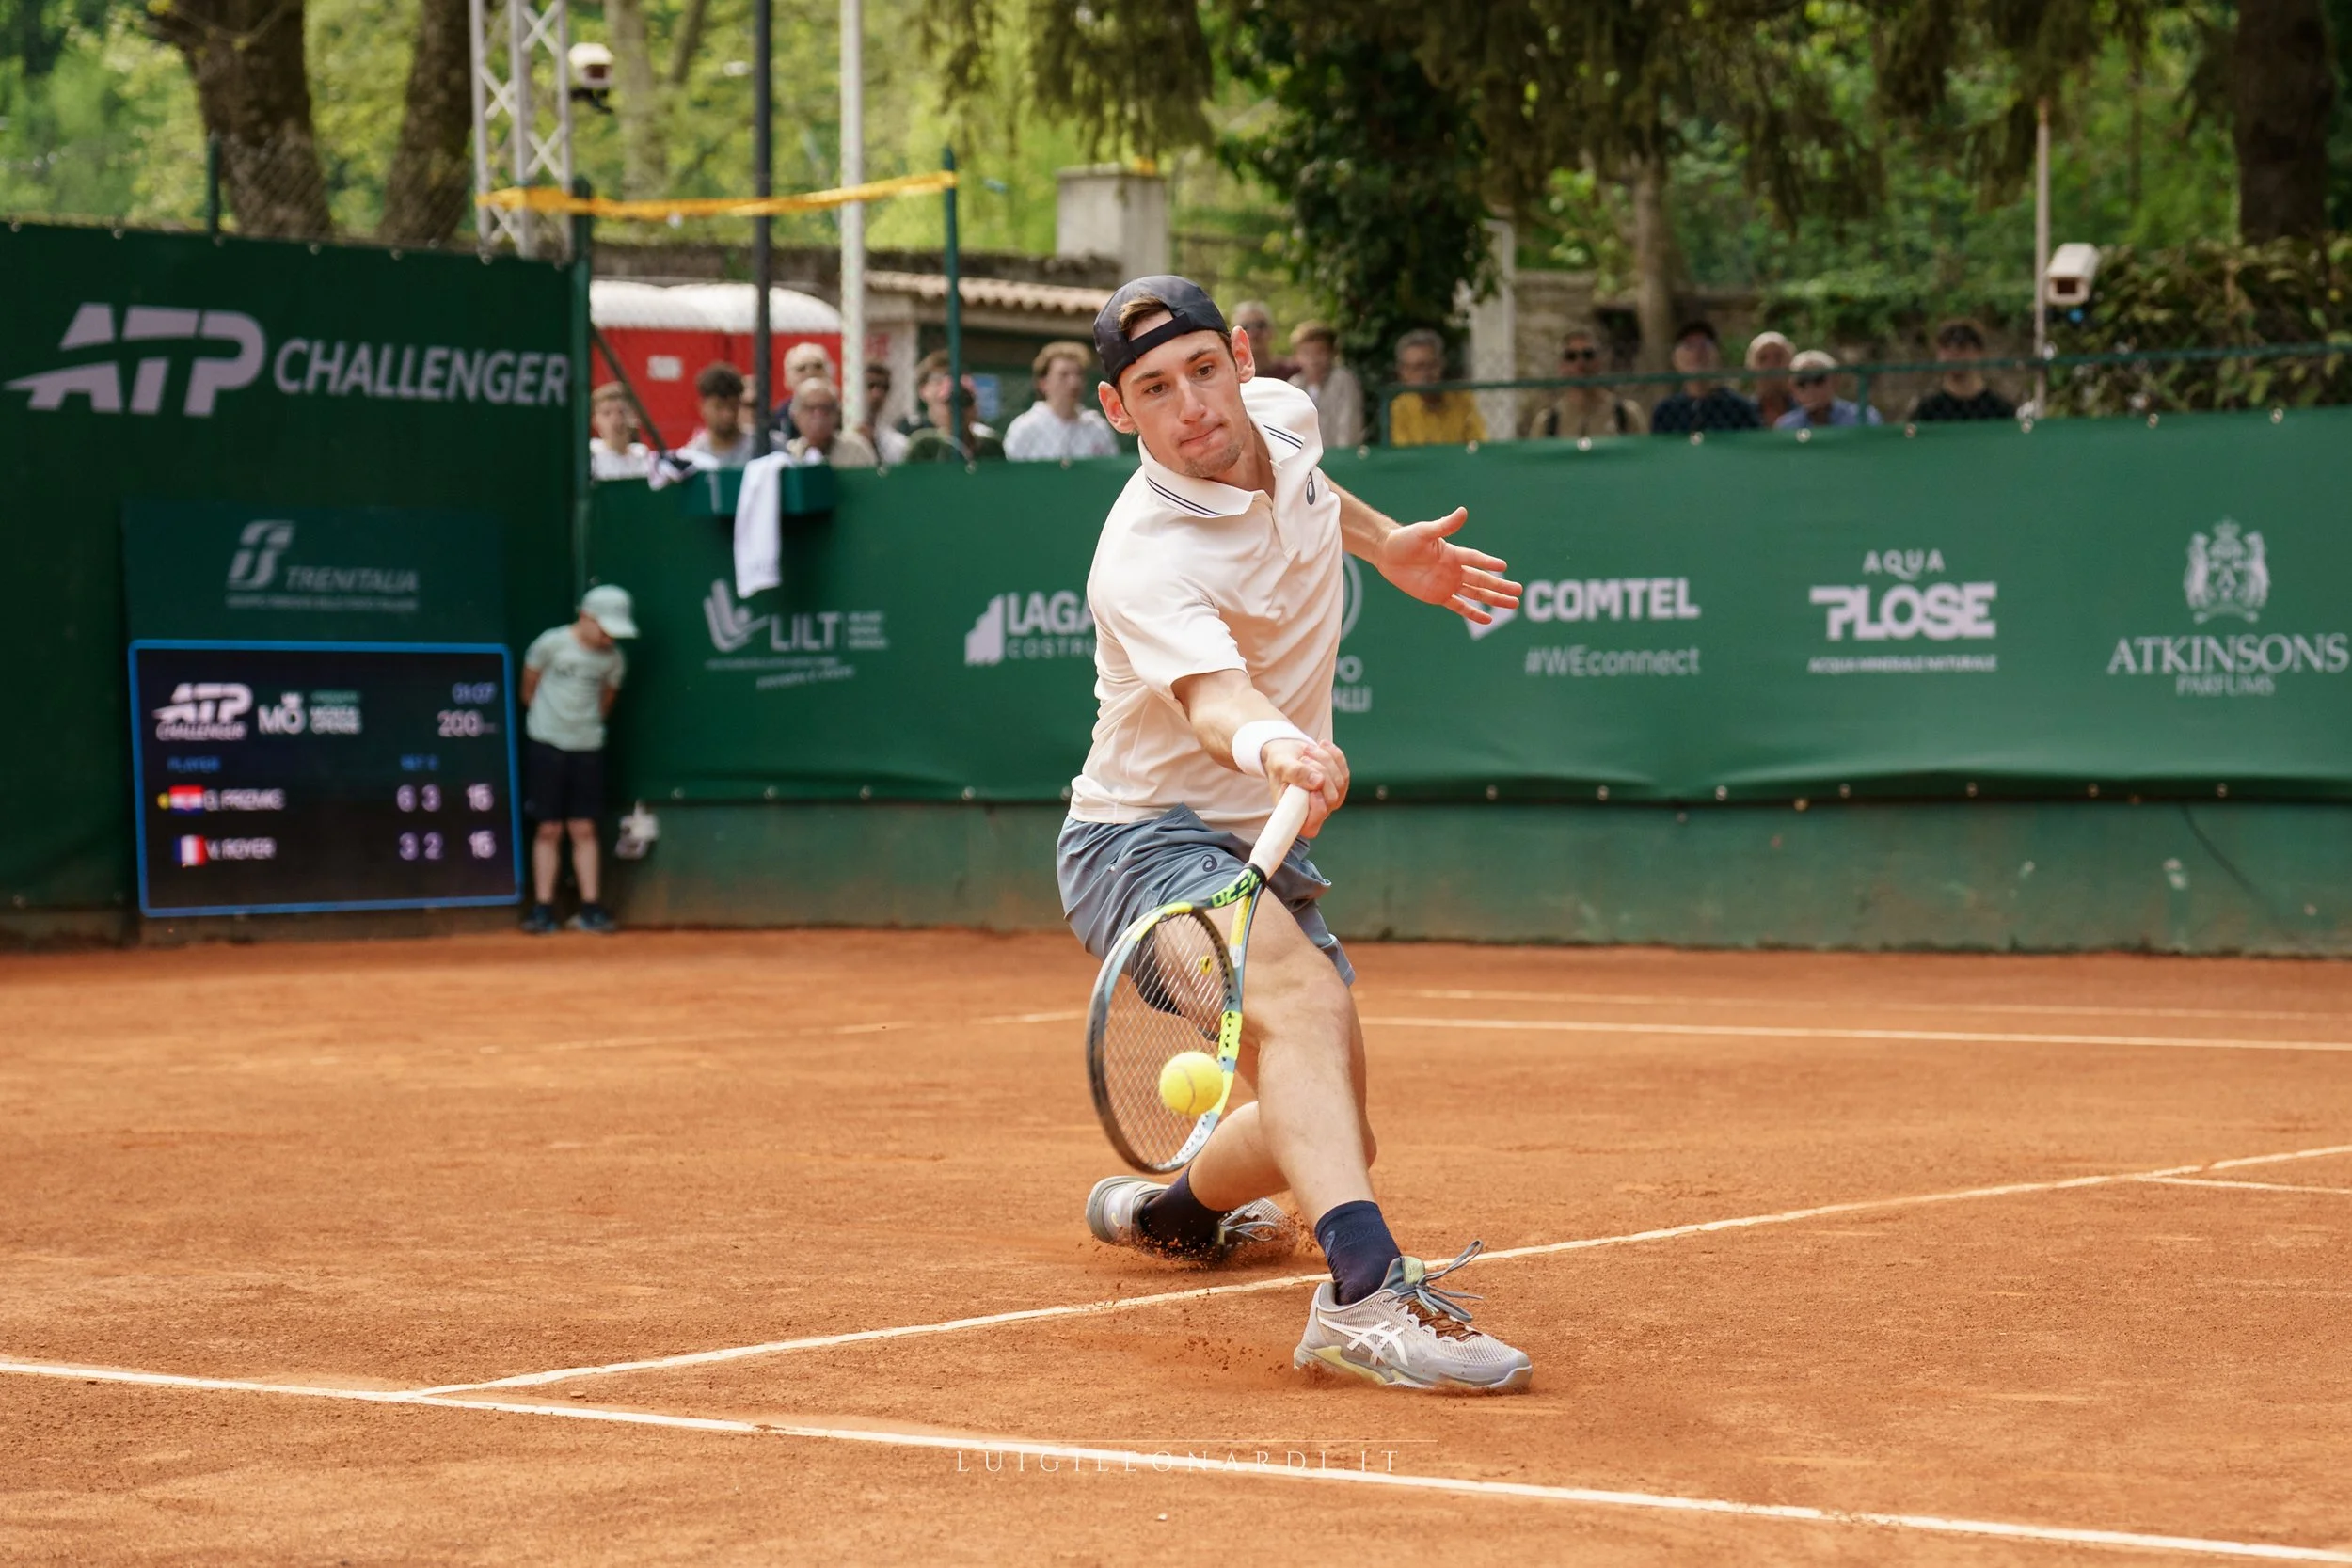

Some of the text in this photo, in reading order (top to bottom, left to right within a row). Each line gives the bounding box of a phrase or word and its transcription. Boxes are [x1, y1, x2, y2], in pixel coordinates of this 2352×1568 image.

[6, 303, 570, 416] ATP CHALLENGER
[286, 567, 419, 594] TRENITALIA
[1863, 549, 1945, 580] AQUA
[1525, 578, 1700, 622] COMTEL
[1809, 582, 1996, 641] PLOSE
[770, 613, 840, 651] LILT
[1525, 645, 1700, 676] #WEconnect
[2107, 633, 2350, 674] ATKINSONS
[152, 683, 253, 722] ATP
[437, 710, 484, 737] 200
[397, 784, 416, 812] 6
[421, 784, 441, 812] 3
[399, 832, 419, 861] 3
[424, 832, 443, 860] 2
